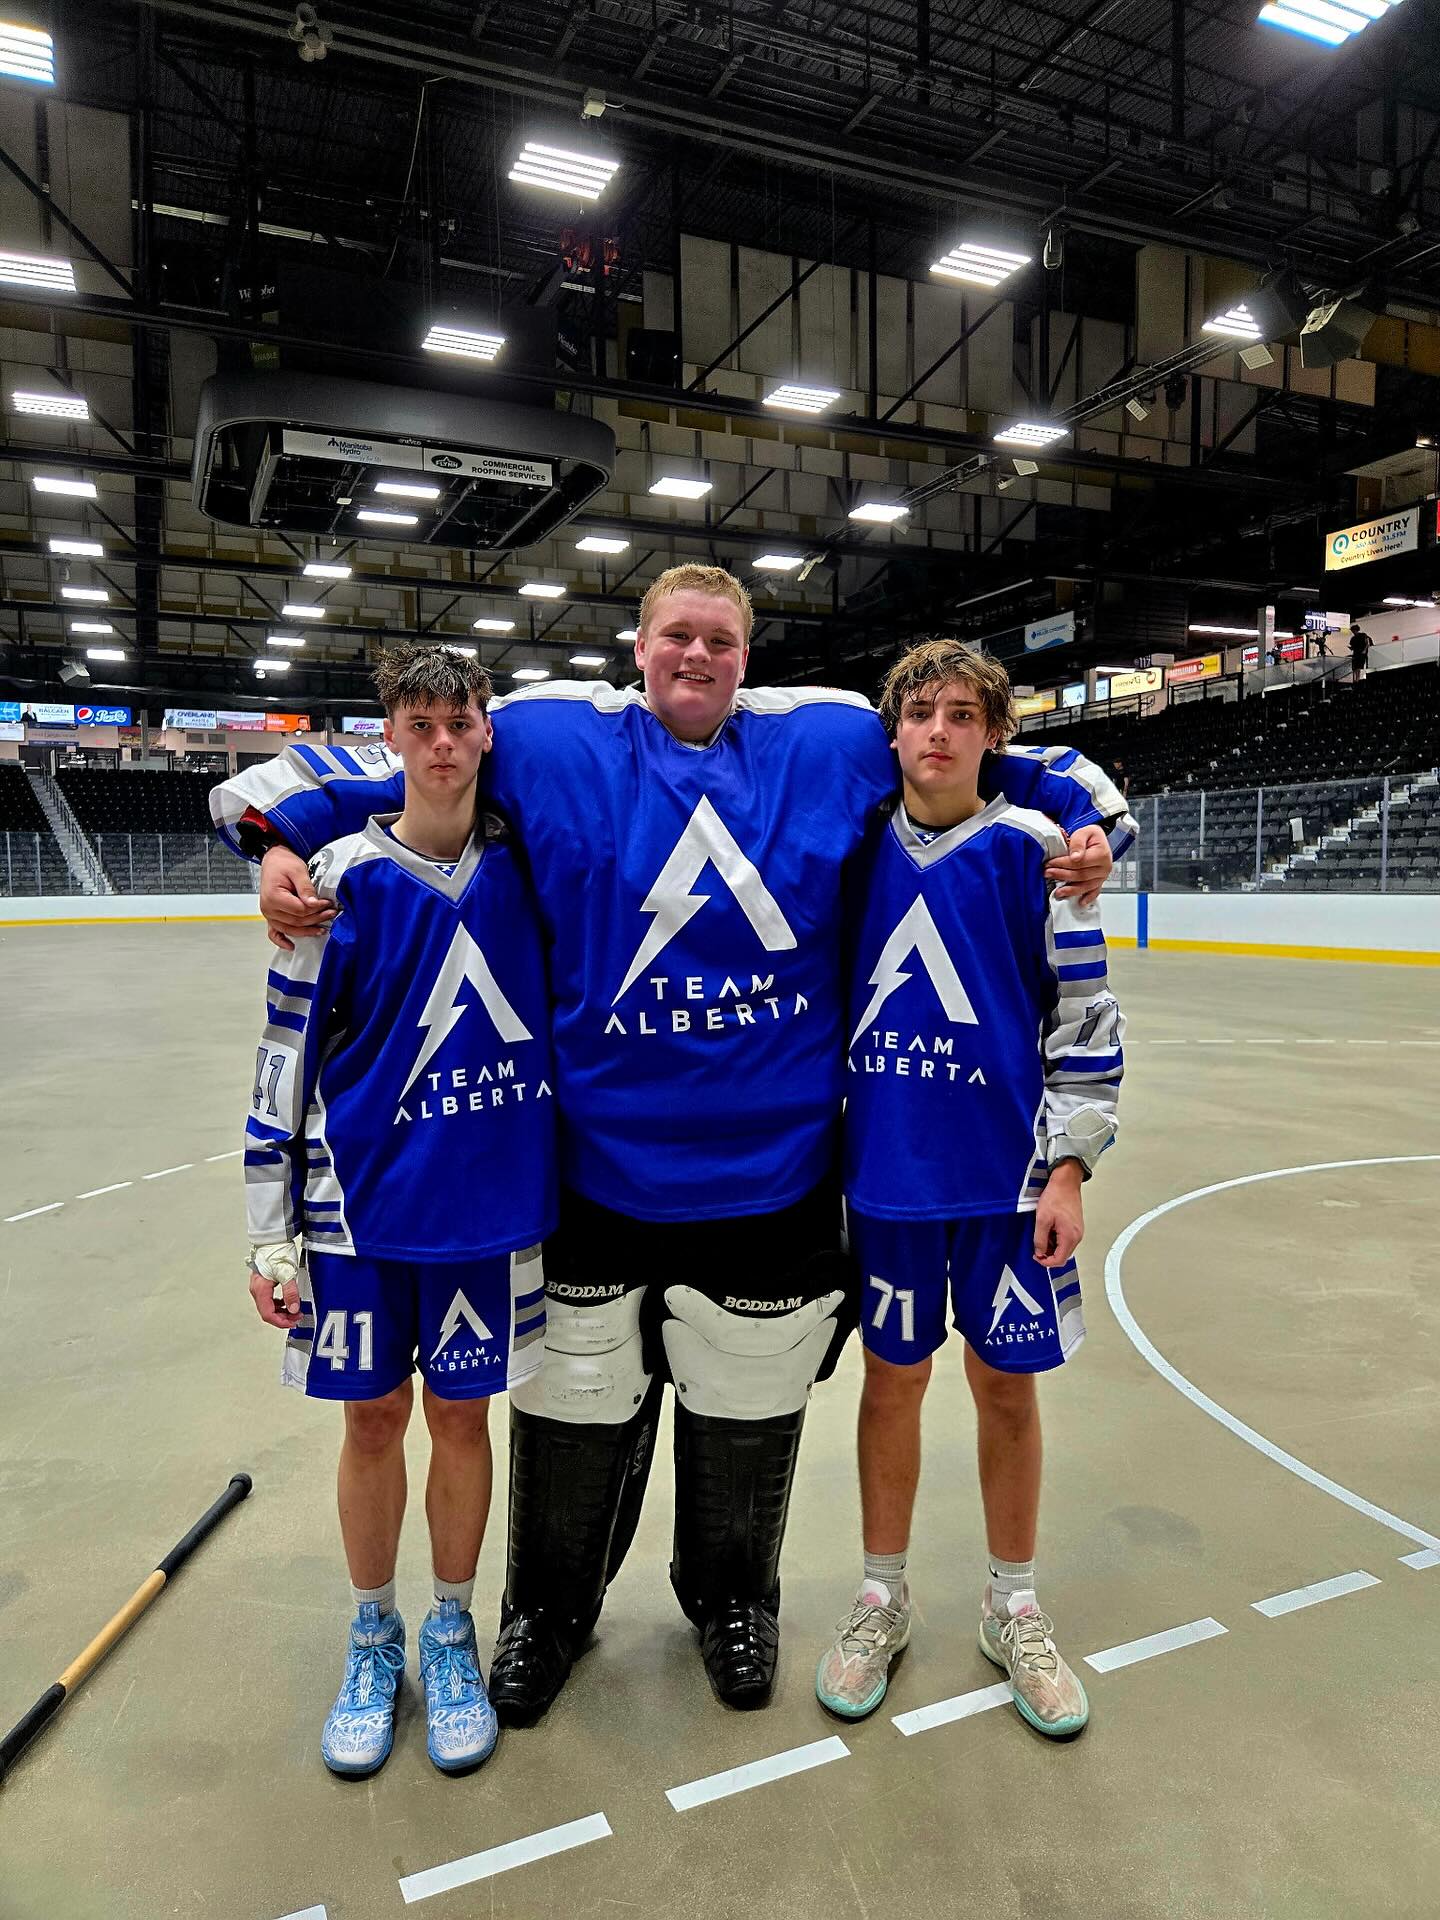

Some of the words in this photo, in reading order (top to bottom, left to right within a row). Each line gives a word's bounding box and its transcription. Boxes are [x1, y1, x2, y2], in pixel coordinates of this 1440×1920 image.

[340, 441, 372, 451] Manitoba
[340, 447, 361, 456] Hydro
[435, 458, 459, 468] FLYNN
[482, 460, 535, 473] COMMERCIAL
[472, 466, 507, 477] ROOFING
[508, 471, 546, 481] SERVICES
[1351, 516, 1411, 542] COUNTRY
[1340, 552, 1366, 563] Country
[1366, 547, 1384, 557] Lives
[1384, 541, 1403, 552] Here!
[650, 974, 774, 1000] TEAM
[604, 993, 808, 1034] ALBERTA
[872, 1031, 954, 1055] TEAM
[427, 1060, 515, 1091] TEAM
[393, 1079, 552, 1125] ALBERTA
[546, 1281, 625, 1298] BODDAM
[723, 1296, 803, 1312] BODDAM
[869, 1274, 914, 1341] 71
[998, 1321, 1040, 1334] TEAM
[316, 1310, 373, 1371] 41
[985, 1328, 1055, 1345] ALBERTA
[441, 1346, 486, 1360] TEAM
[429, 1354, 502, 1372] ALBERTA
